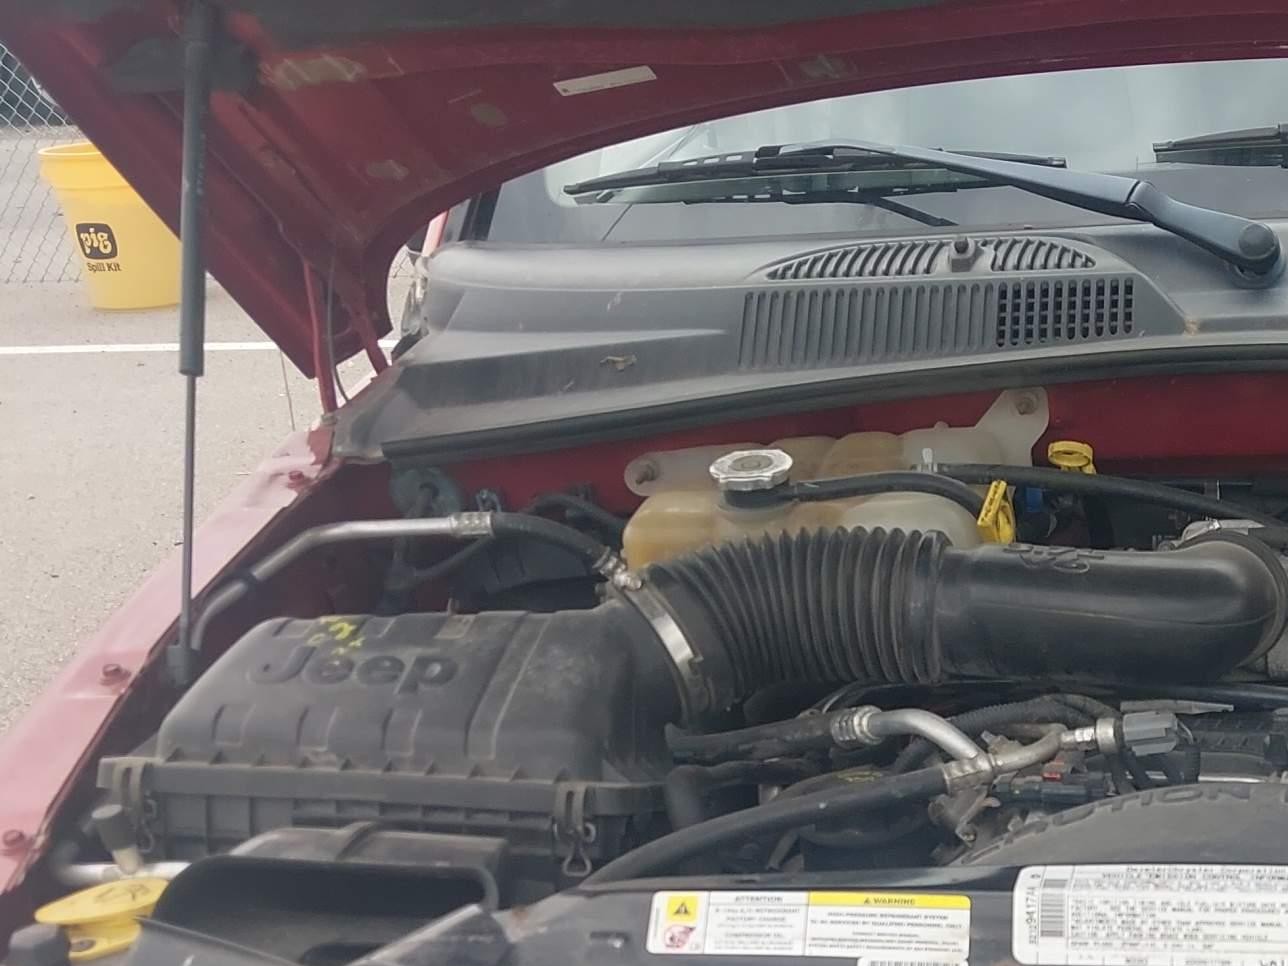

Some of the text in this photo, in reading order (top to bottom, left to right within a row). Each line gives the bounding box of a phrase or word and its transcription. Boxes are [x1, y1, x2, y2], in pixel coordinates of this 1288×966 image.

[80, 227, 112, 254] pig
[87, 262, 121, 273] Spill Kit
[245, 645, 460, 696] Jeep
